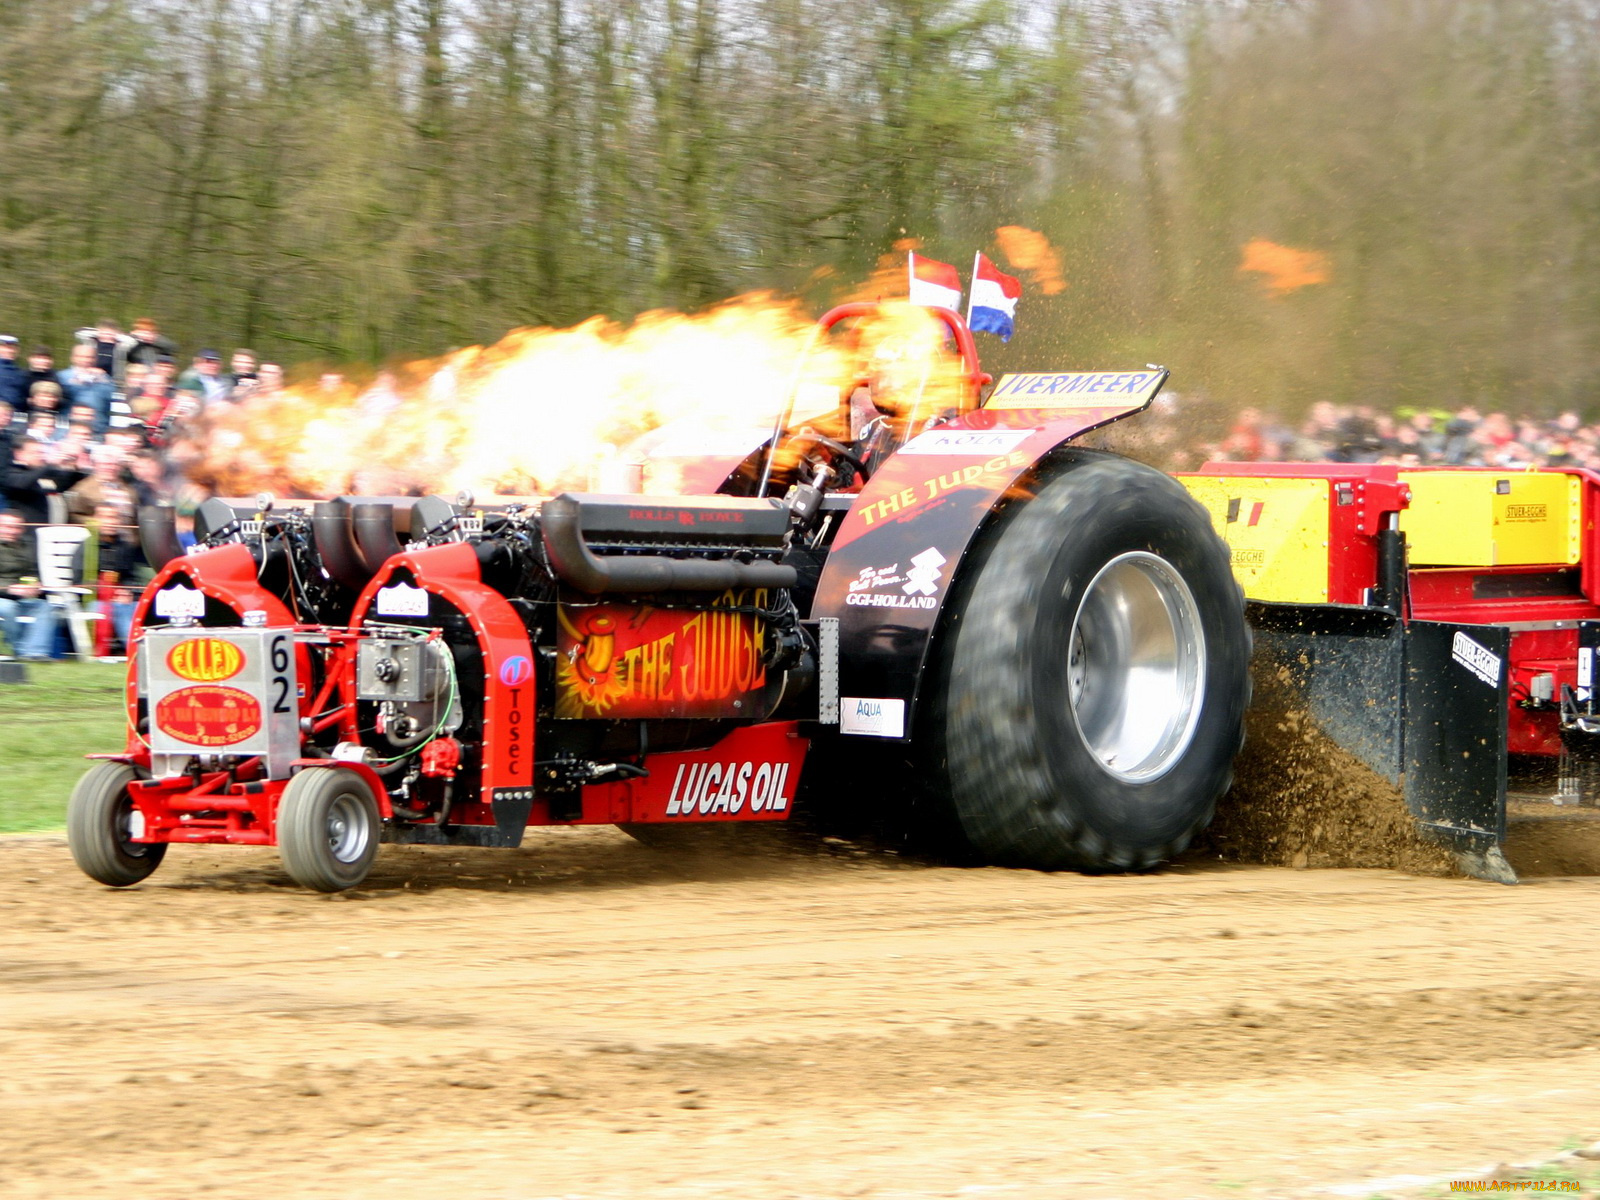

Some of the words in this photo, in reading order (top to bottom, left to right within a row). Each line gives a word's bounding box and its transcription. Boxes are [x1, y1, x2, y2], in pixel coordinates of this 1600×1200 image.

[858, 487, 918, 526] THE
[924, 450, 1026, 499] JUDGE
[629, 509, 675, 520] ROLLS
[700, 512, 744, 523] ROYCE
[1230, 551, 1263, 561] -EGGHE
[845, 593, 937, 609] GGI-HOLLAND
[171, 638, 241, 680] ELLEN
[624, 632, 676, 701] THE
[680, 587, 769, 701] JUDGE
[666, 761, 753, 815] LUCAS
[751, 762, 789, 812] OIL
